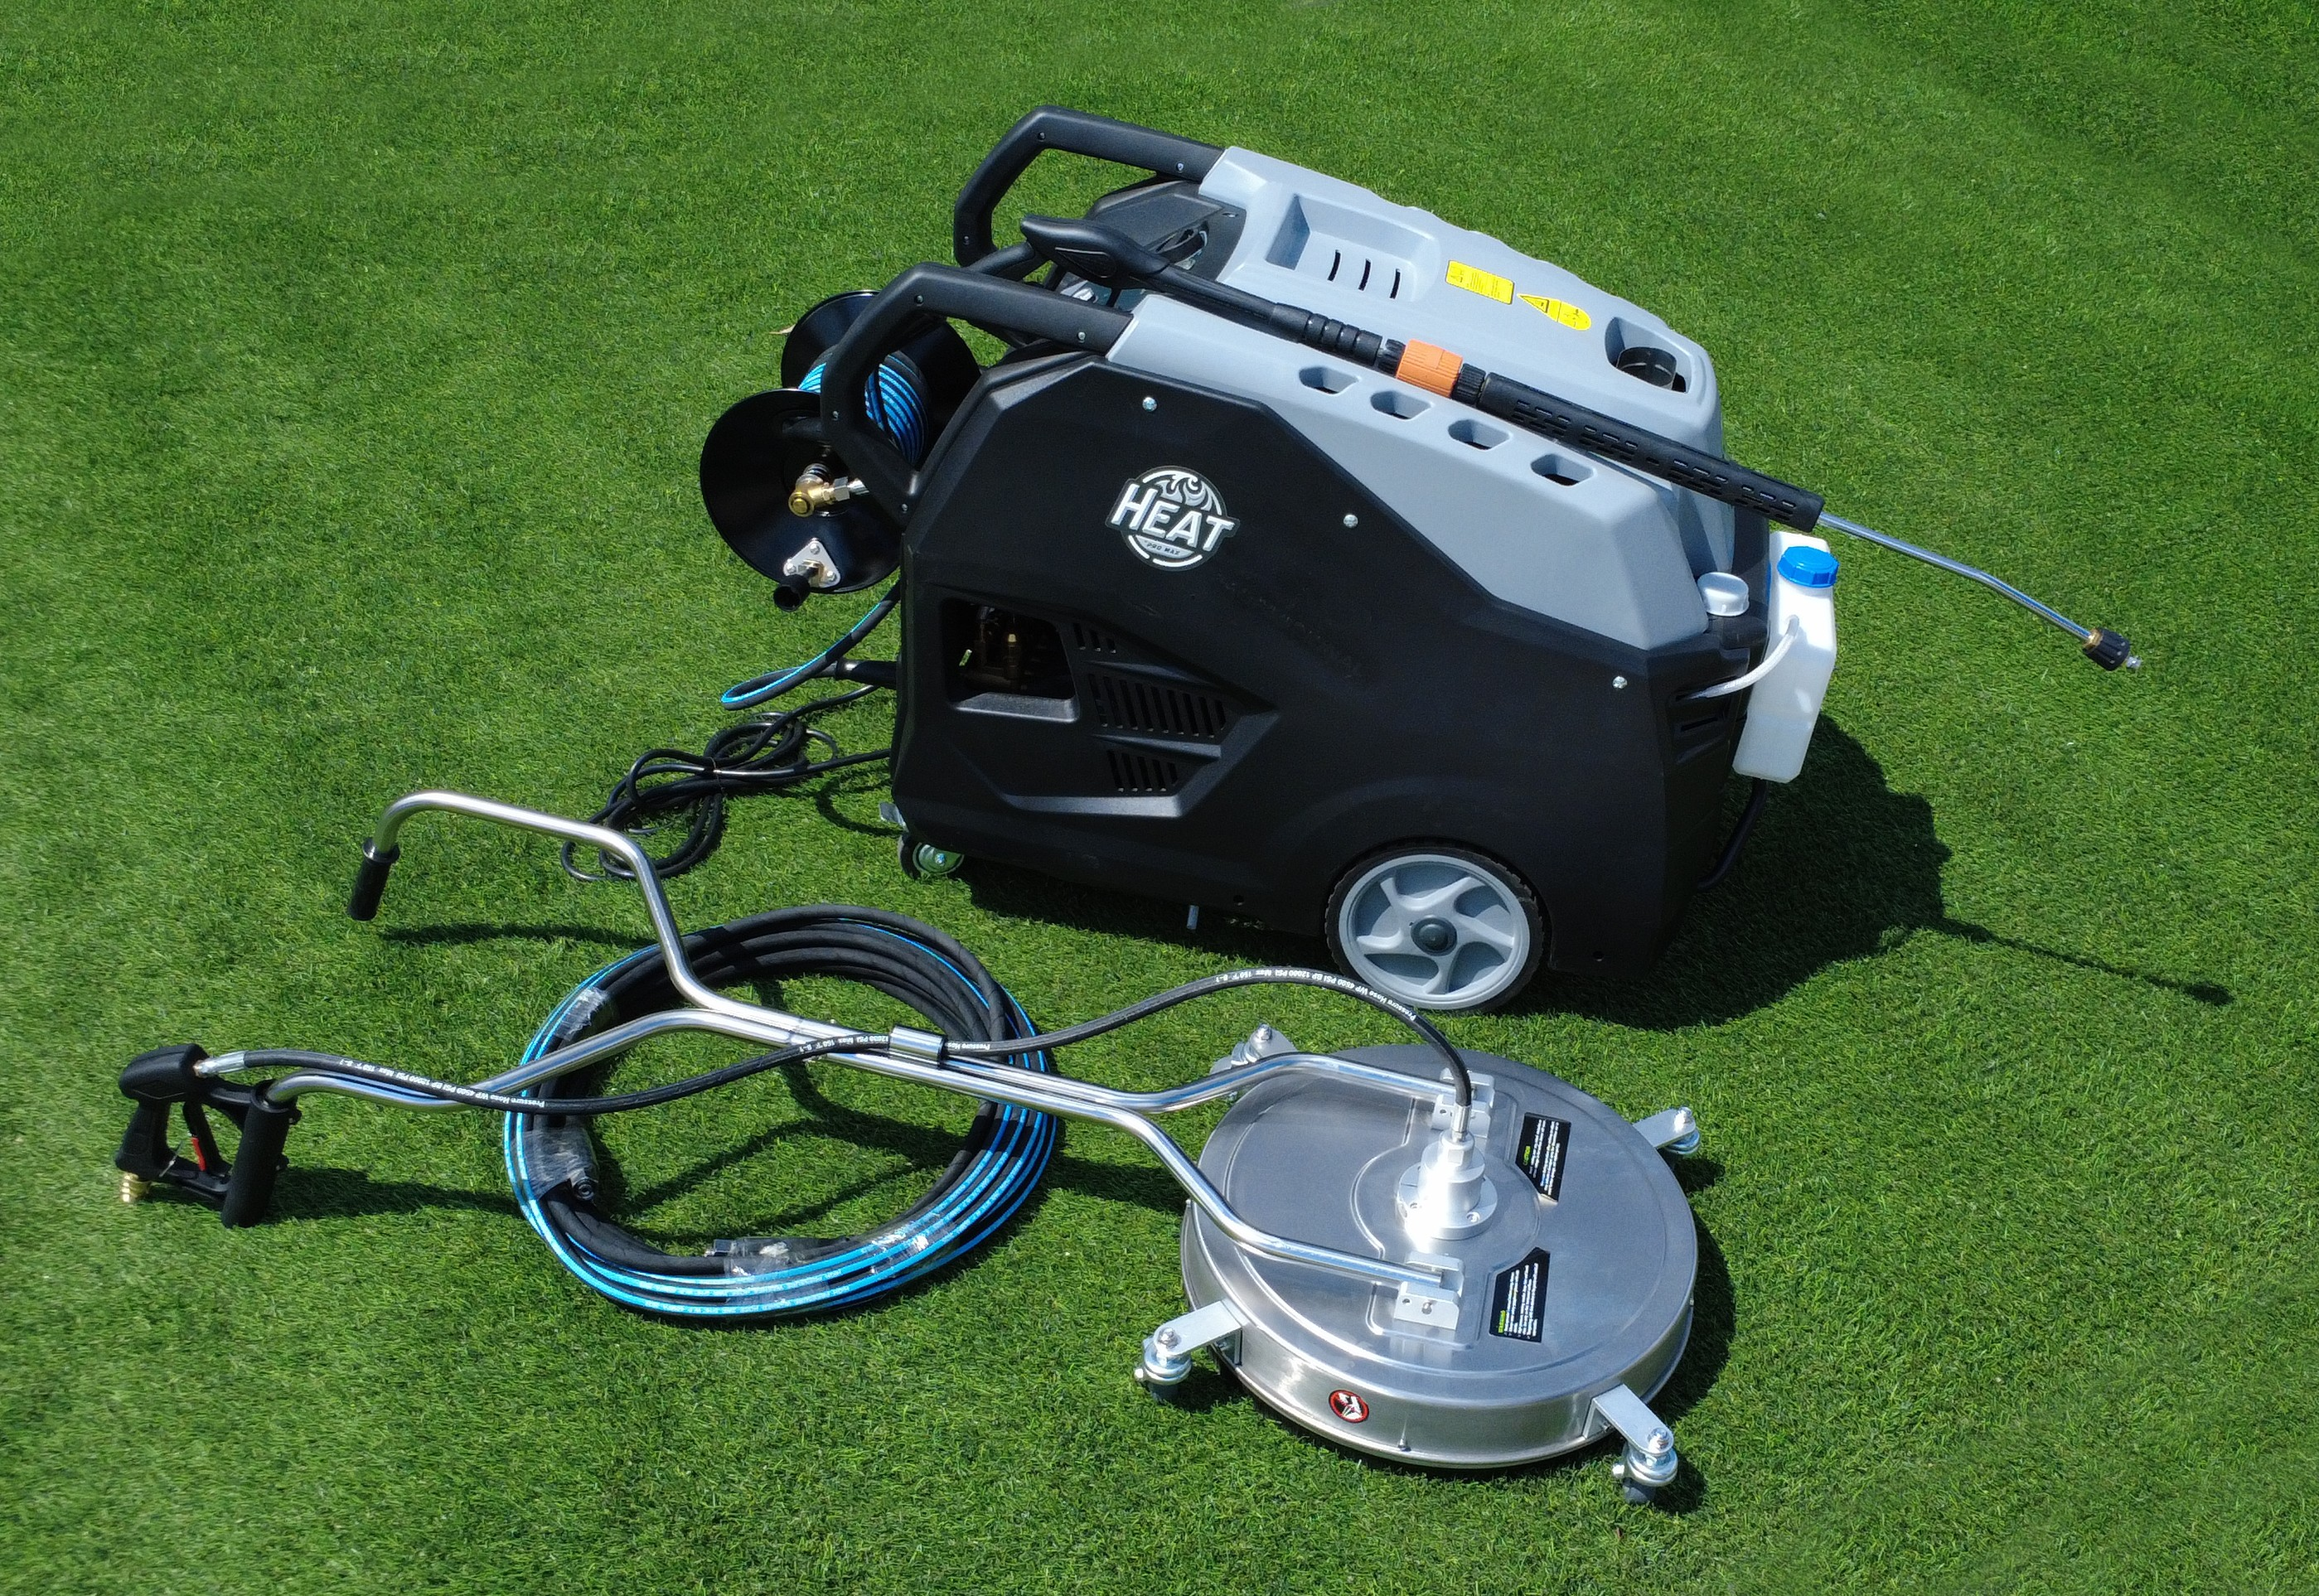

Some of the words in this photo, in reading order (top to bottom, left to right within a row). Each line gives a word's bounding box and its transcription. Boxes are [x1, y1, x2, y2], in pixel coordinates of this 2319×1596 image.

[1111, 483, 1235, 552] HEAT
[1146, 543, 1163, 551] PRO
[1164, 547, 1181, 556] MAX
[1289, 970, 1310, 978] 12000
[1324, 975, 1337, 984] PSI
[1355, 985, 1368, 996] WP
[1369, 990, 1387, 1005] Hose
[1387, 999, 1416, 1021] Pressure
[945, 1042, 961, 1050] Hos
[378, 1067, 395, 1077] Max
[396, 1072, 409, 1081] PSI
[443, 1084, 457, 1092] PSI
[474, 1092, 489, 1100] WP
[490, 1094, 511, 1104] Hose
[511, 1097, 545, 1108] Pressure
